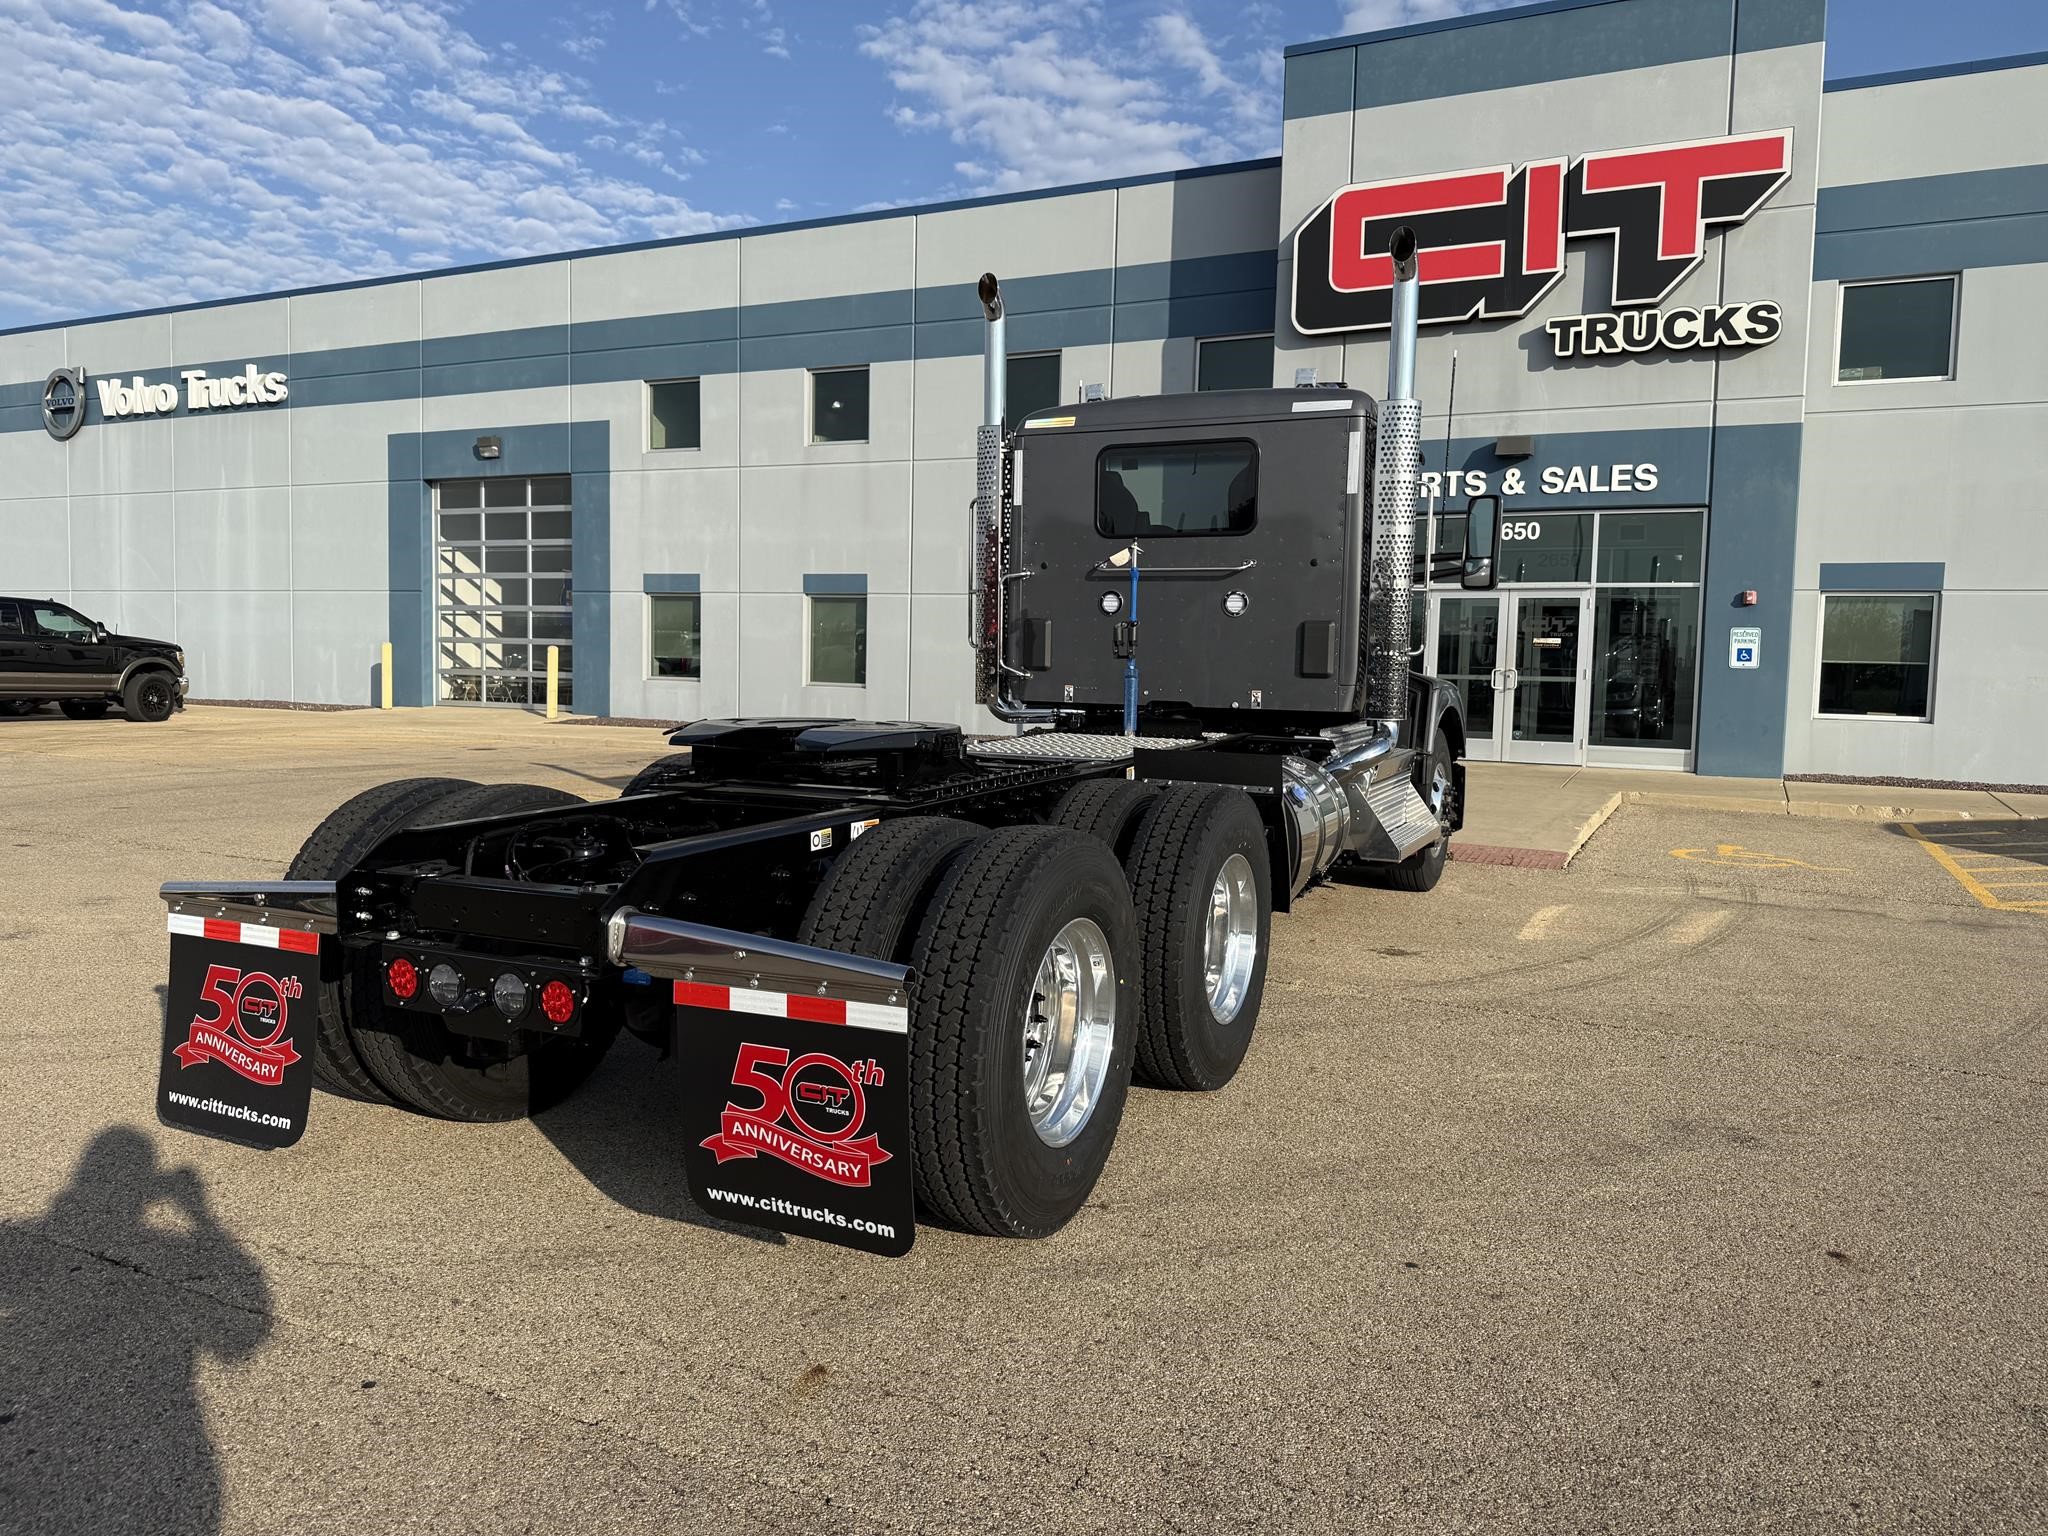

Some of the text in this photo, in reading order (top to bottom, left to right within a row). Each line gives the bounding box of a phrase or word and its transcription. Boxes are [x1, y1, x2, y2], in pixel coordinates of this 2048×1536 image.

[1292, 127, 1794, 335] CIT
[1546, 301, 1783, 357] TRUCKS
[46, 397, 75, 407] VOLVO
[97, 364, 288, 417] Volvo Trucks
[1418, 463, 1658, 498] RTS & SALES
[1501, 521, 1541, 541] 650
[242, 996, 278, 1017] CIT
[195, 1031, 279, 1078] ANNIVERSARY
[168, 1090, 291, 1130] www.cittrucks.com
[796, 1082, 850, 1107] CIT
[825, 1107, 850, 1116] TRUCKS
[732, 1121, 862, 1179] ANNIVERSARY
[707, 1187, 896, 1239] www.cittrucks.com
